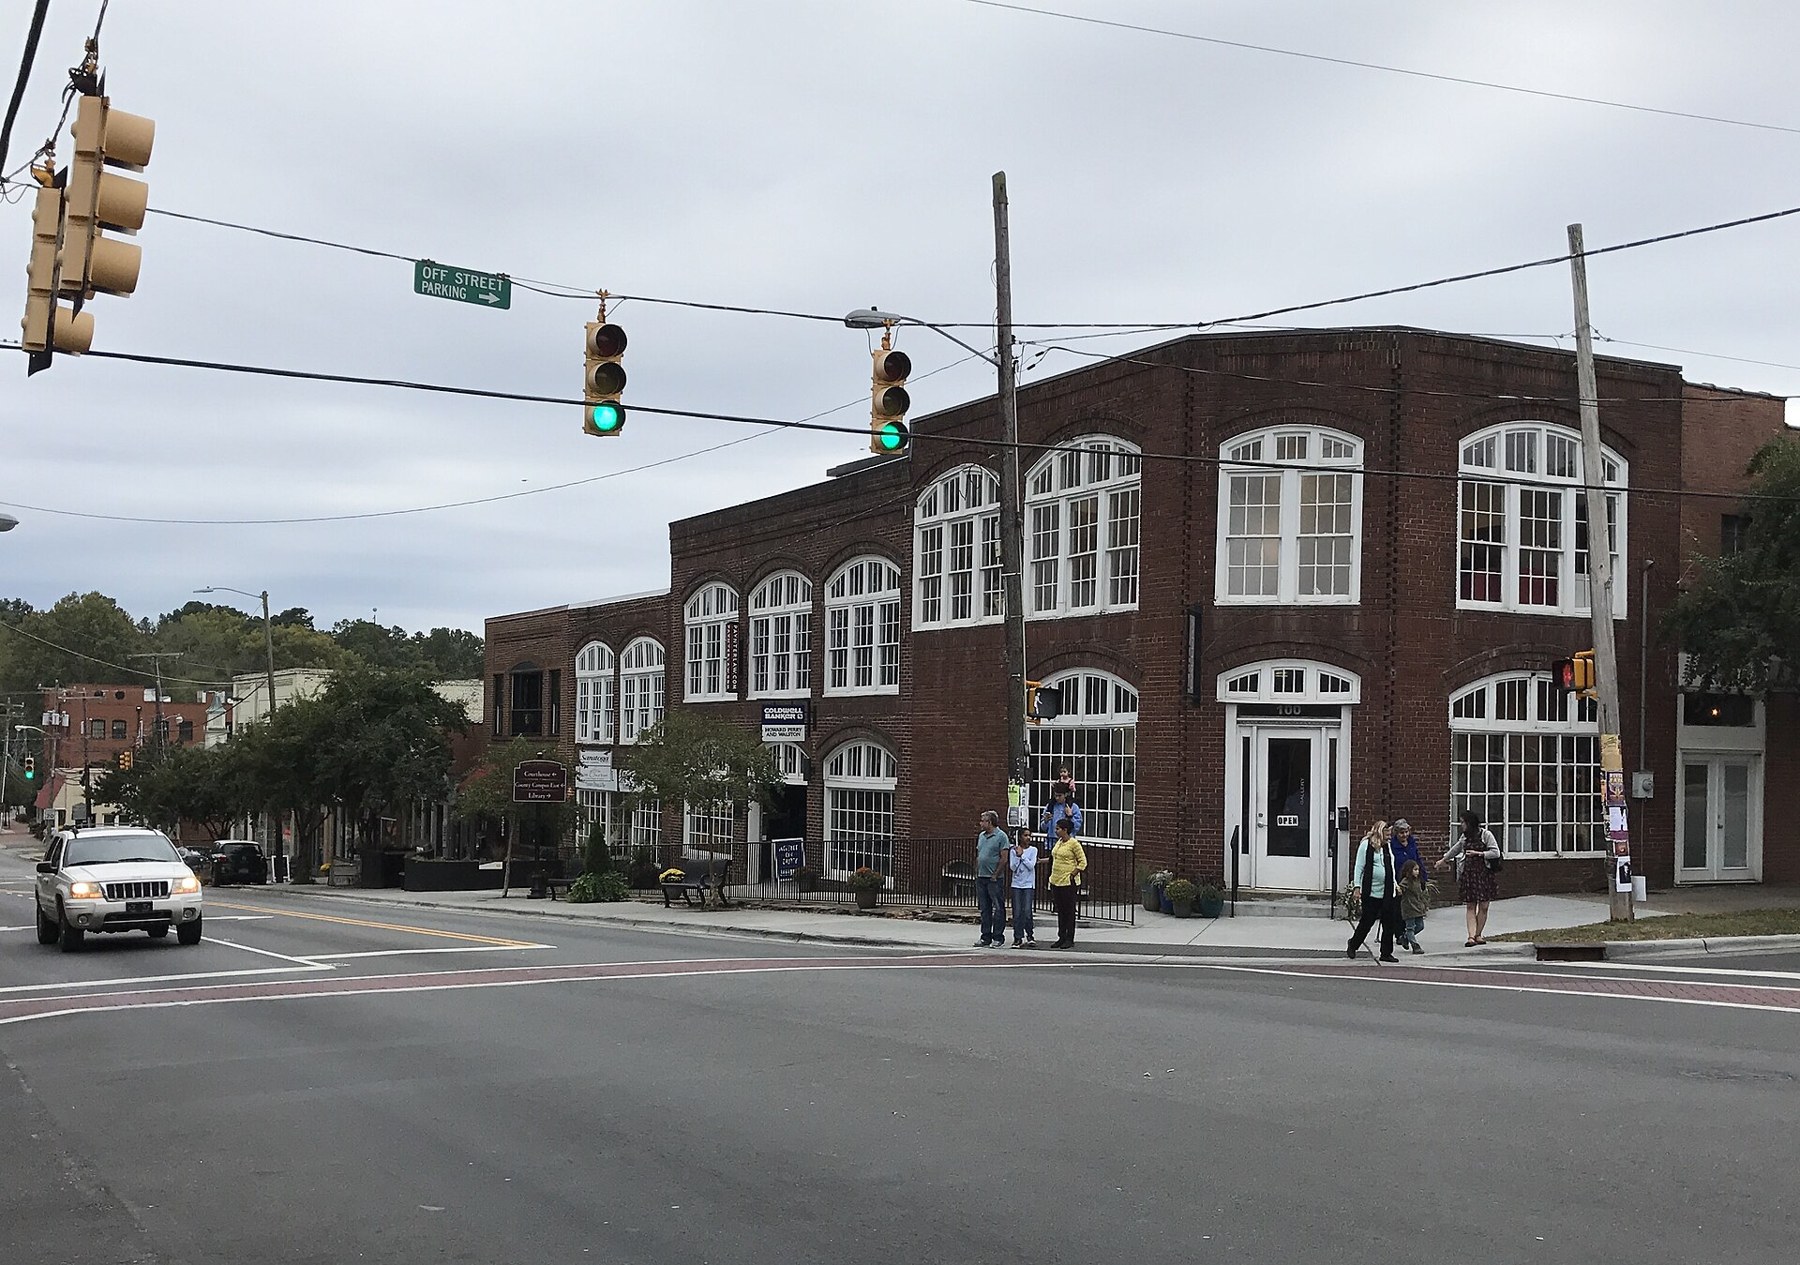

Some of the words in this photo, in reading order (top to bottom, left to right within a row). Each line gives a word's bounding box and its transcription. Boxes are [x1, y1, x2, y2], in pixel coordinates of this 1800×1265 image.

[422, 266, 449, 281] OFF
[454, 272, 504, 291] STREET
[421, 281, 467, 300] PARKING
[1276, 704, 1301, 715] 100
[1278, 816, 1298, 825] OPEN
